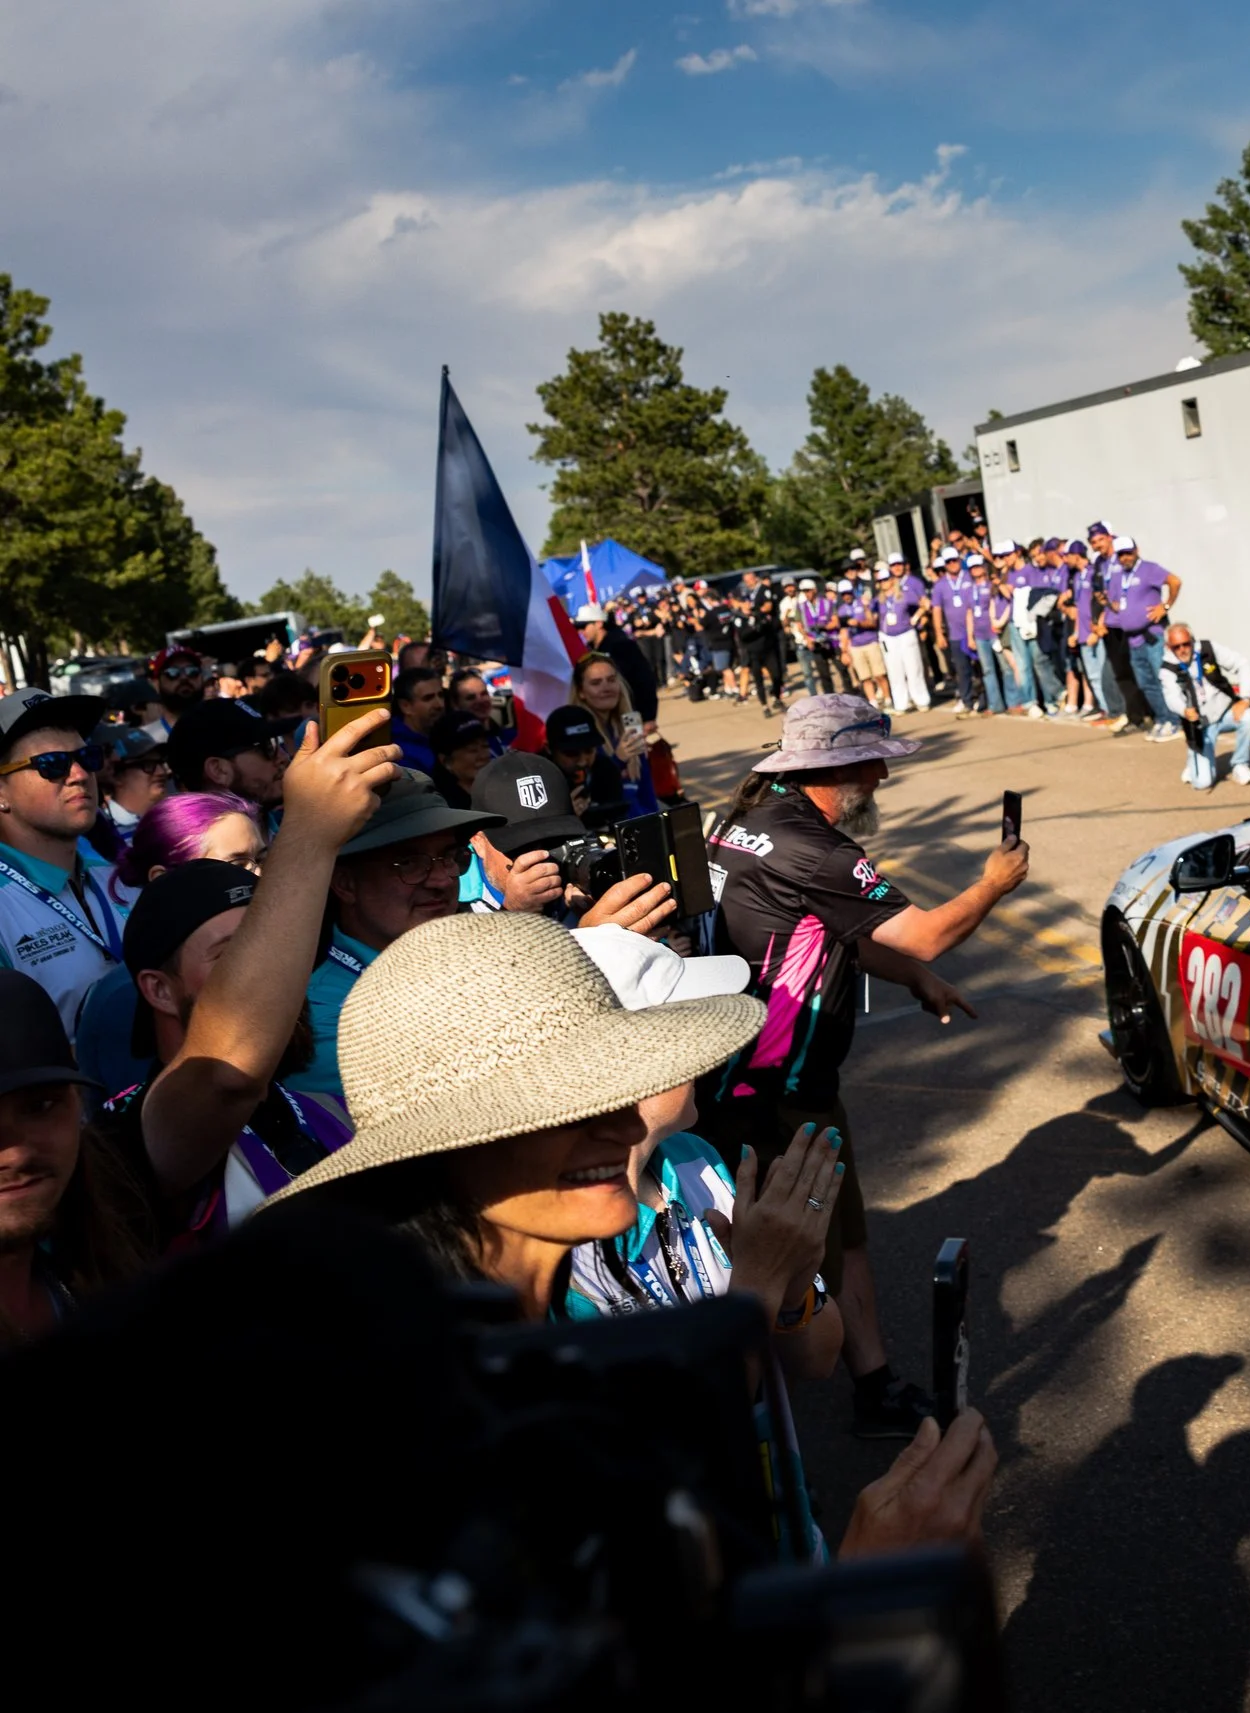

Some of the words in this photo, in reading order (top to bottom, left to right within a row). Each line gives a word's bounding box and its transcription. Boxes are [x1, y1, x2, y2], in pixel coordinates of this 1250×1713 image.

[520, 783, 546, 807] ALS
[6, 868, 40, 894] TIRES
[46, 896, 76, 921] TOYO
[74, 920, 105, 946] TIRES
[17, 937, 48, 956] PIKES
[49, 929, 74, 944] PEAK
[1187, 946, 1243, 1060] 282
